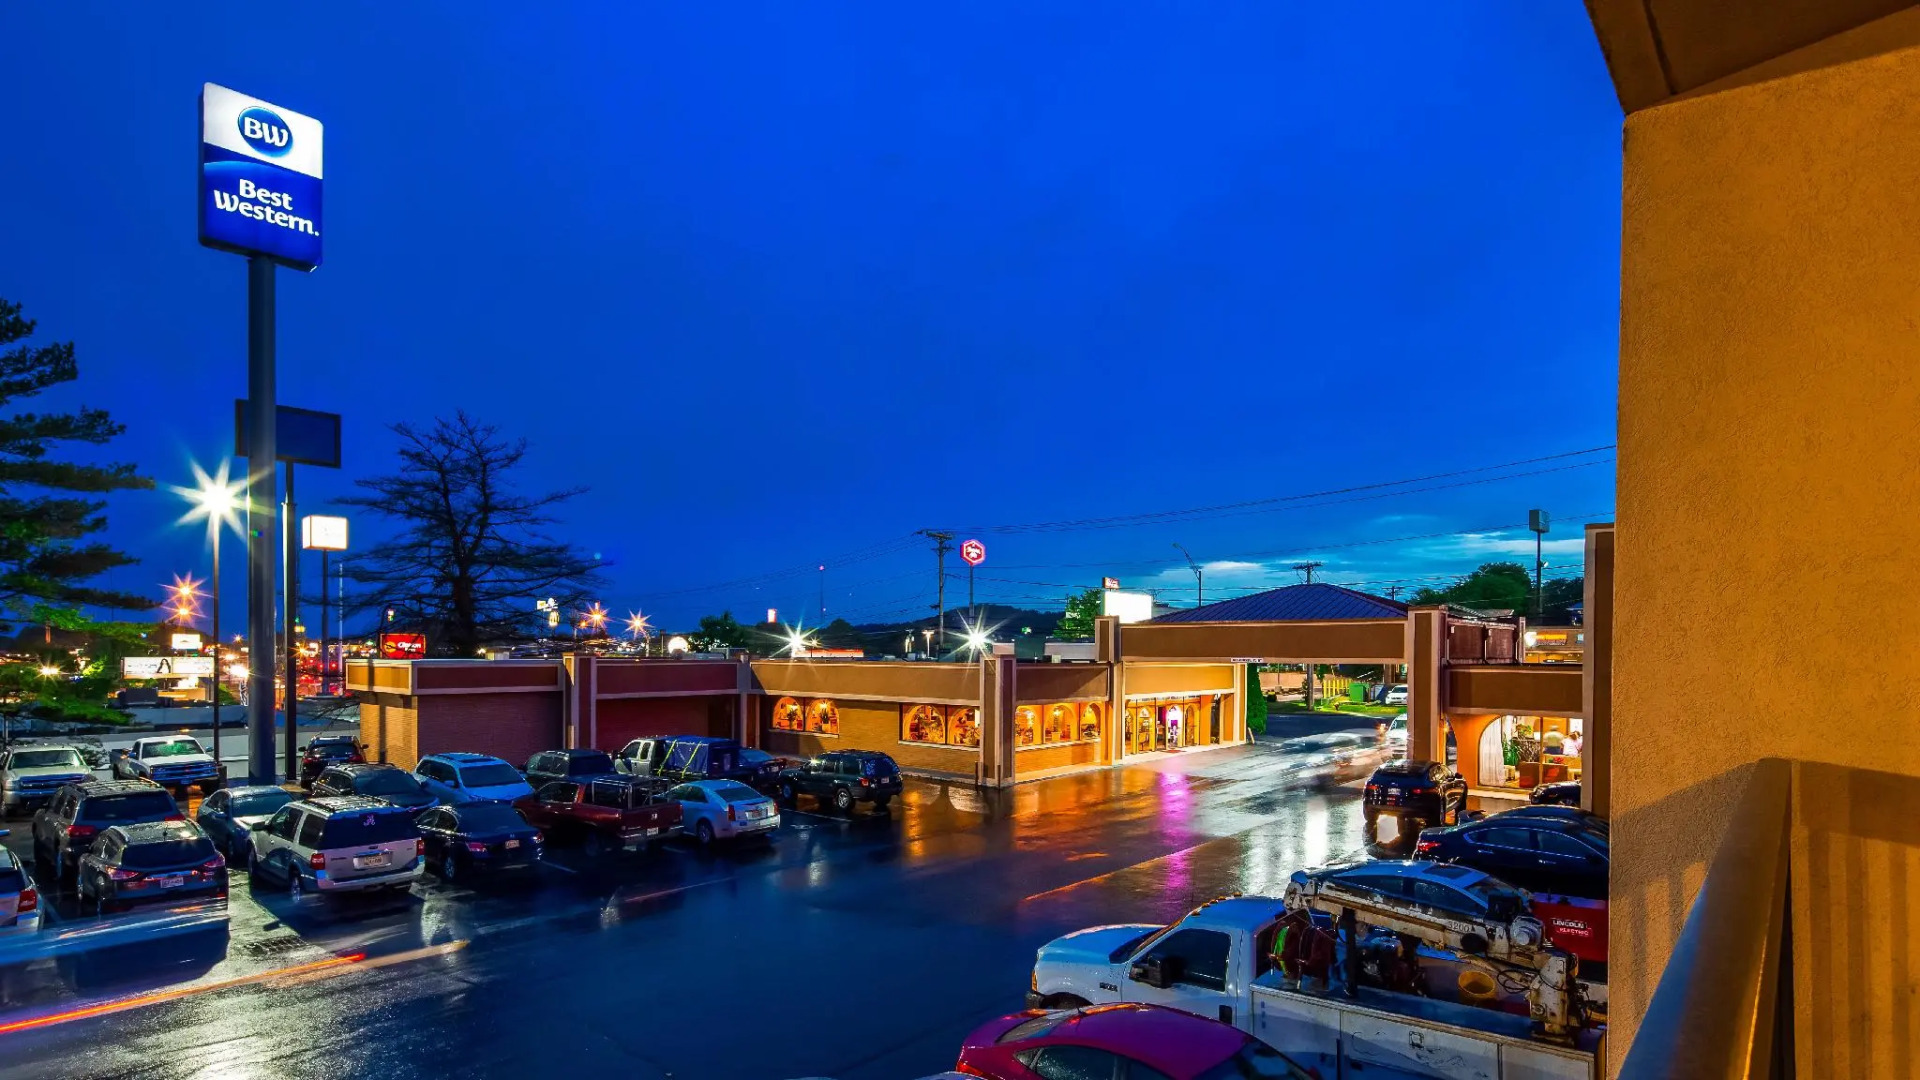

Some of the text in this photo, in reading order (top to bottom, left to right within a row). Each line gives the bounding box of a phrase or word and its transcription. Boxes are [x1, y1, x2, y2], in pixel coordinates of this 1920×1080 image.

[244, 117, 289, 147] BW
[239, 178, 293, 210] Best
[1552, 919, 1585, 929] LINCOLN
